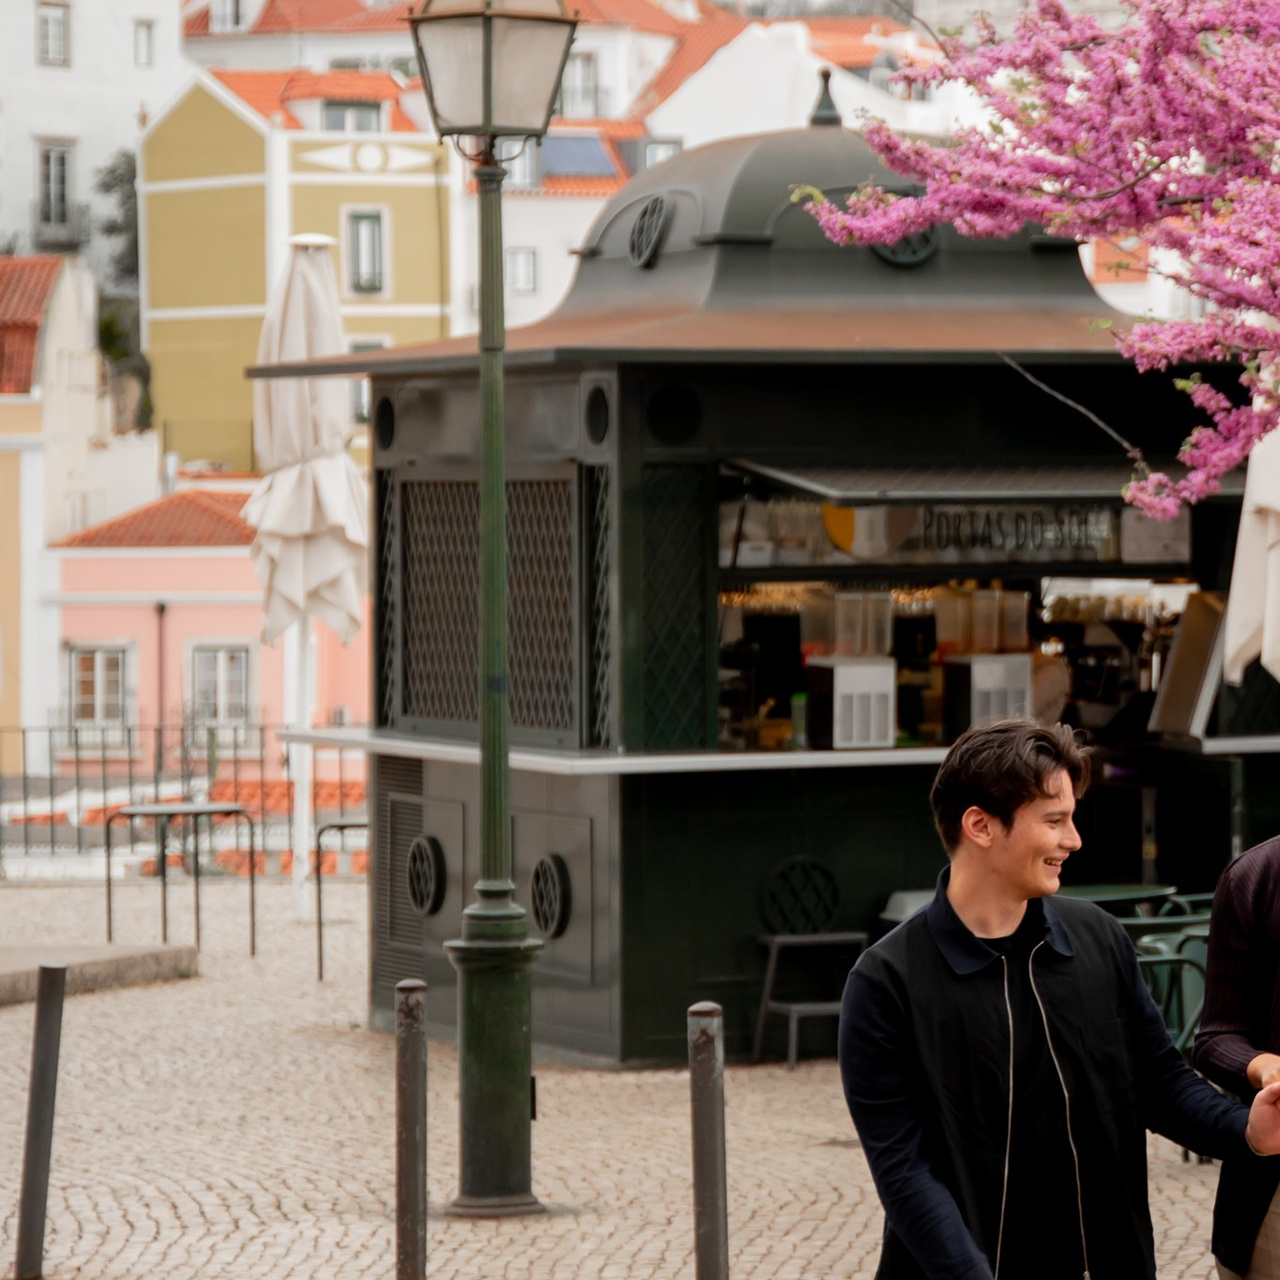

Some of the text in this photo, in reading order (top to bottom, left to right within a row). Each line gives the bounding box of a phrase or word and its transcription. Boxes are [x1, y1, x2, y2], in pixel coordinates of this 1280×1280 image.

[922, 506, 1097, 551] PORTAS DO SOL
